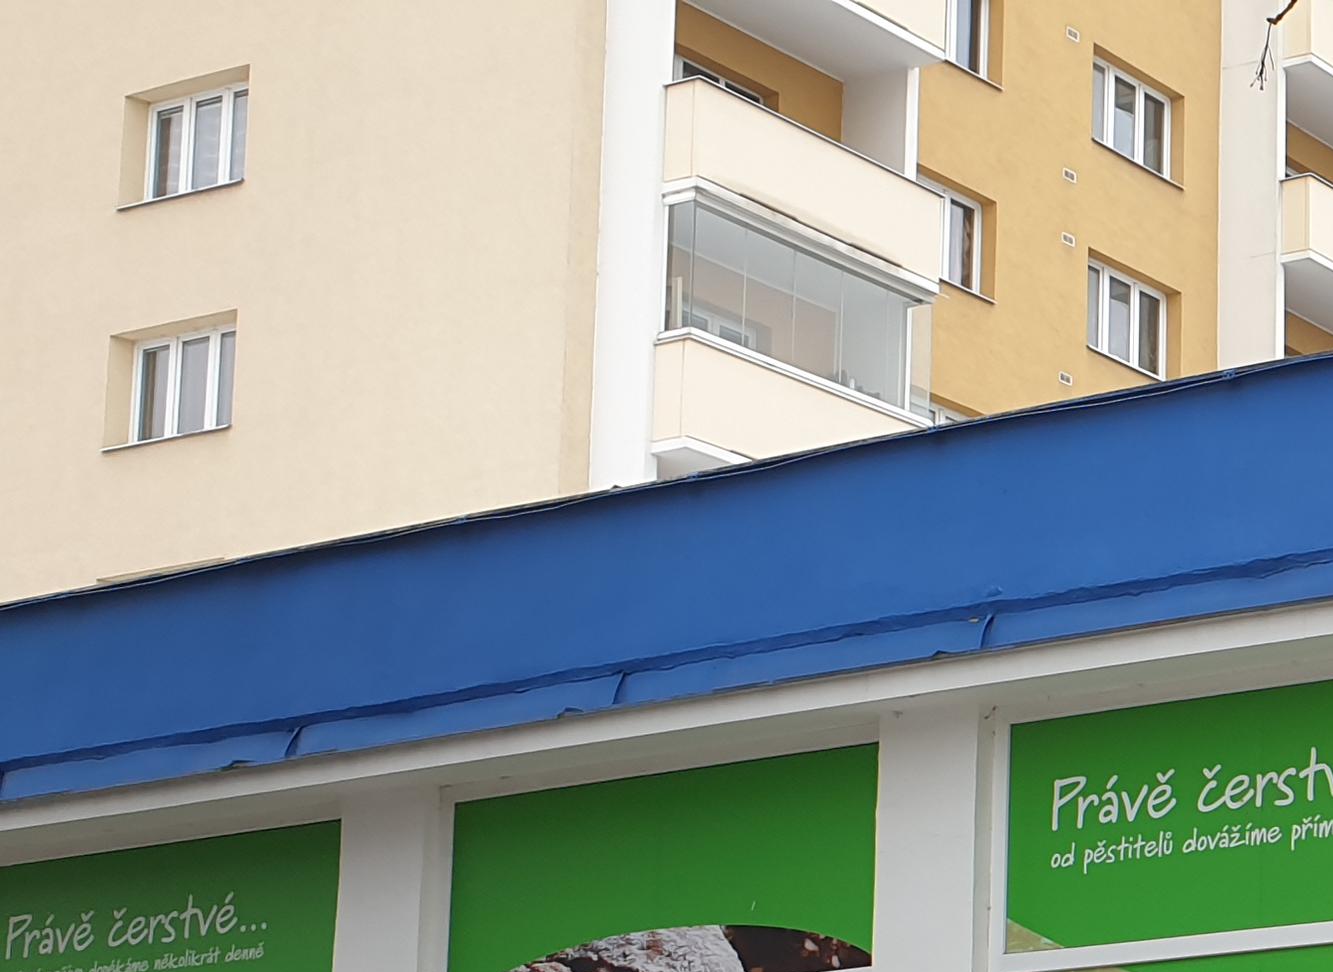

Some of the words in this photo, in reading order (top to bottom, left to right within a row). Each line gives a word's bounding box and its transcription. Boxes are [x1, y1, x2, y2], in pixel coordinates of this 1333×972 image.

[1051, 769, 1177, 832] Právě
[1051, 842, 1075, 869] od
[1084, 831, 1173, 874] pěstitelů
[1183, 823, 1282, 854] dovážíme
[5, 910, 95, 960] Právě
[153, 945, 221, 972] několikrát
[225, 941, 264, 964] denně
